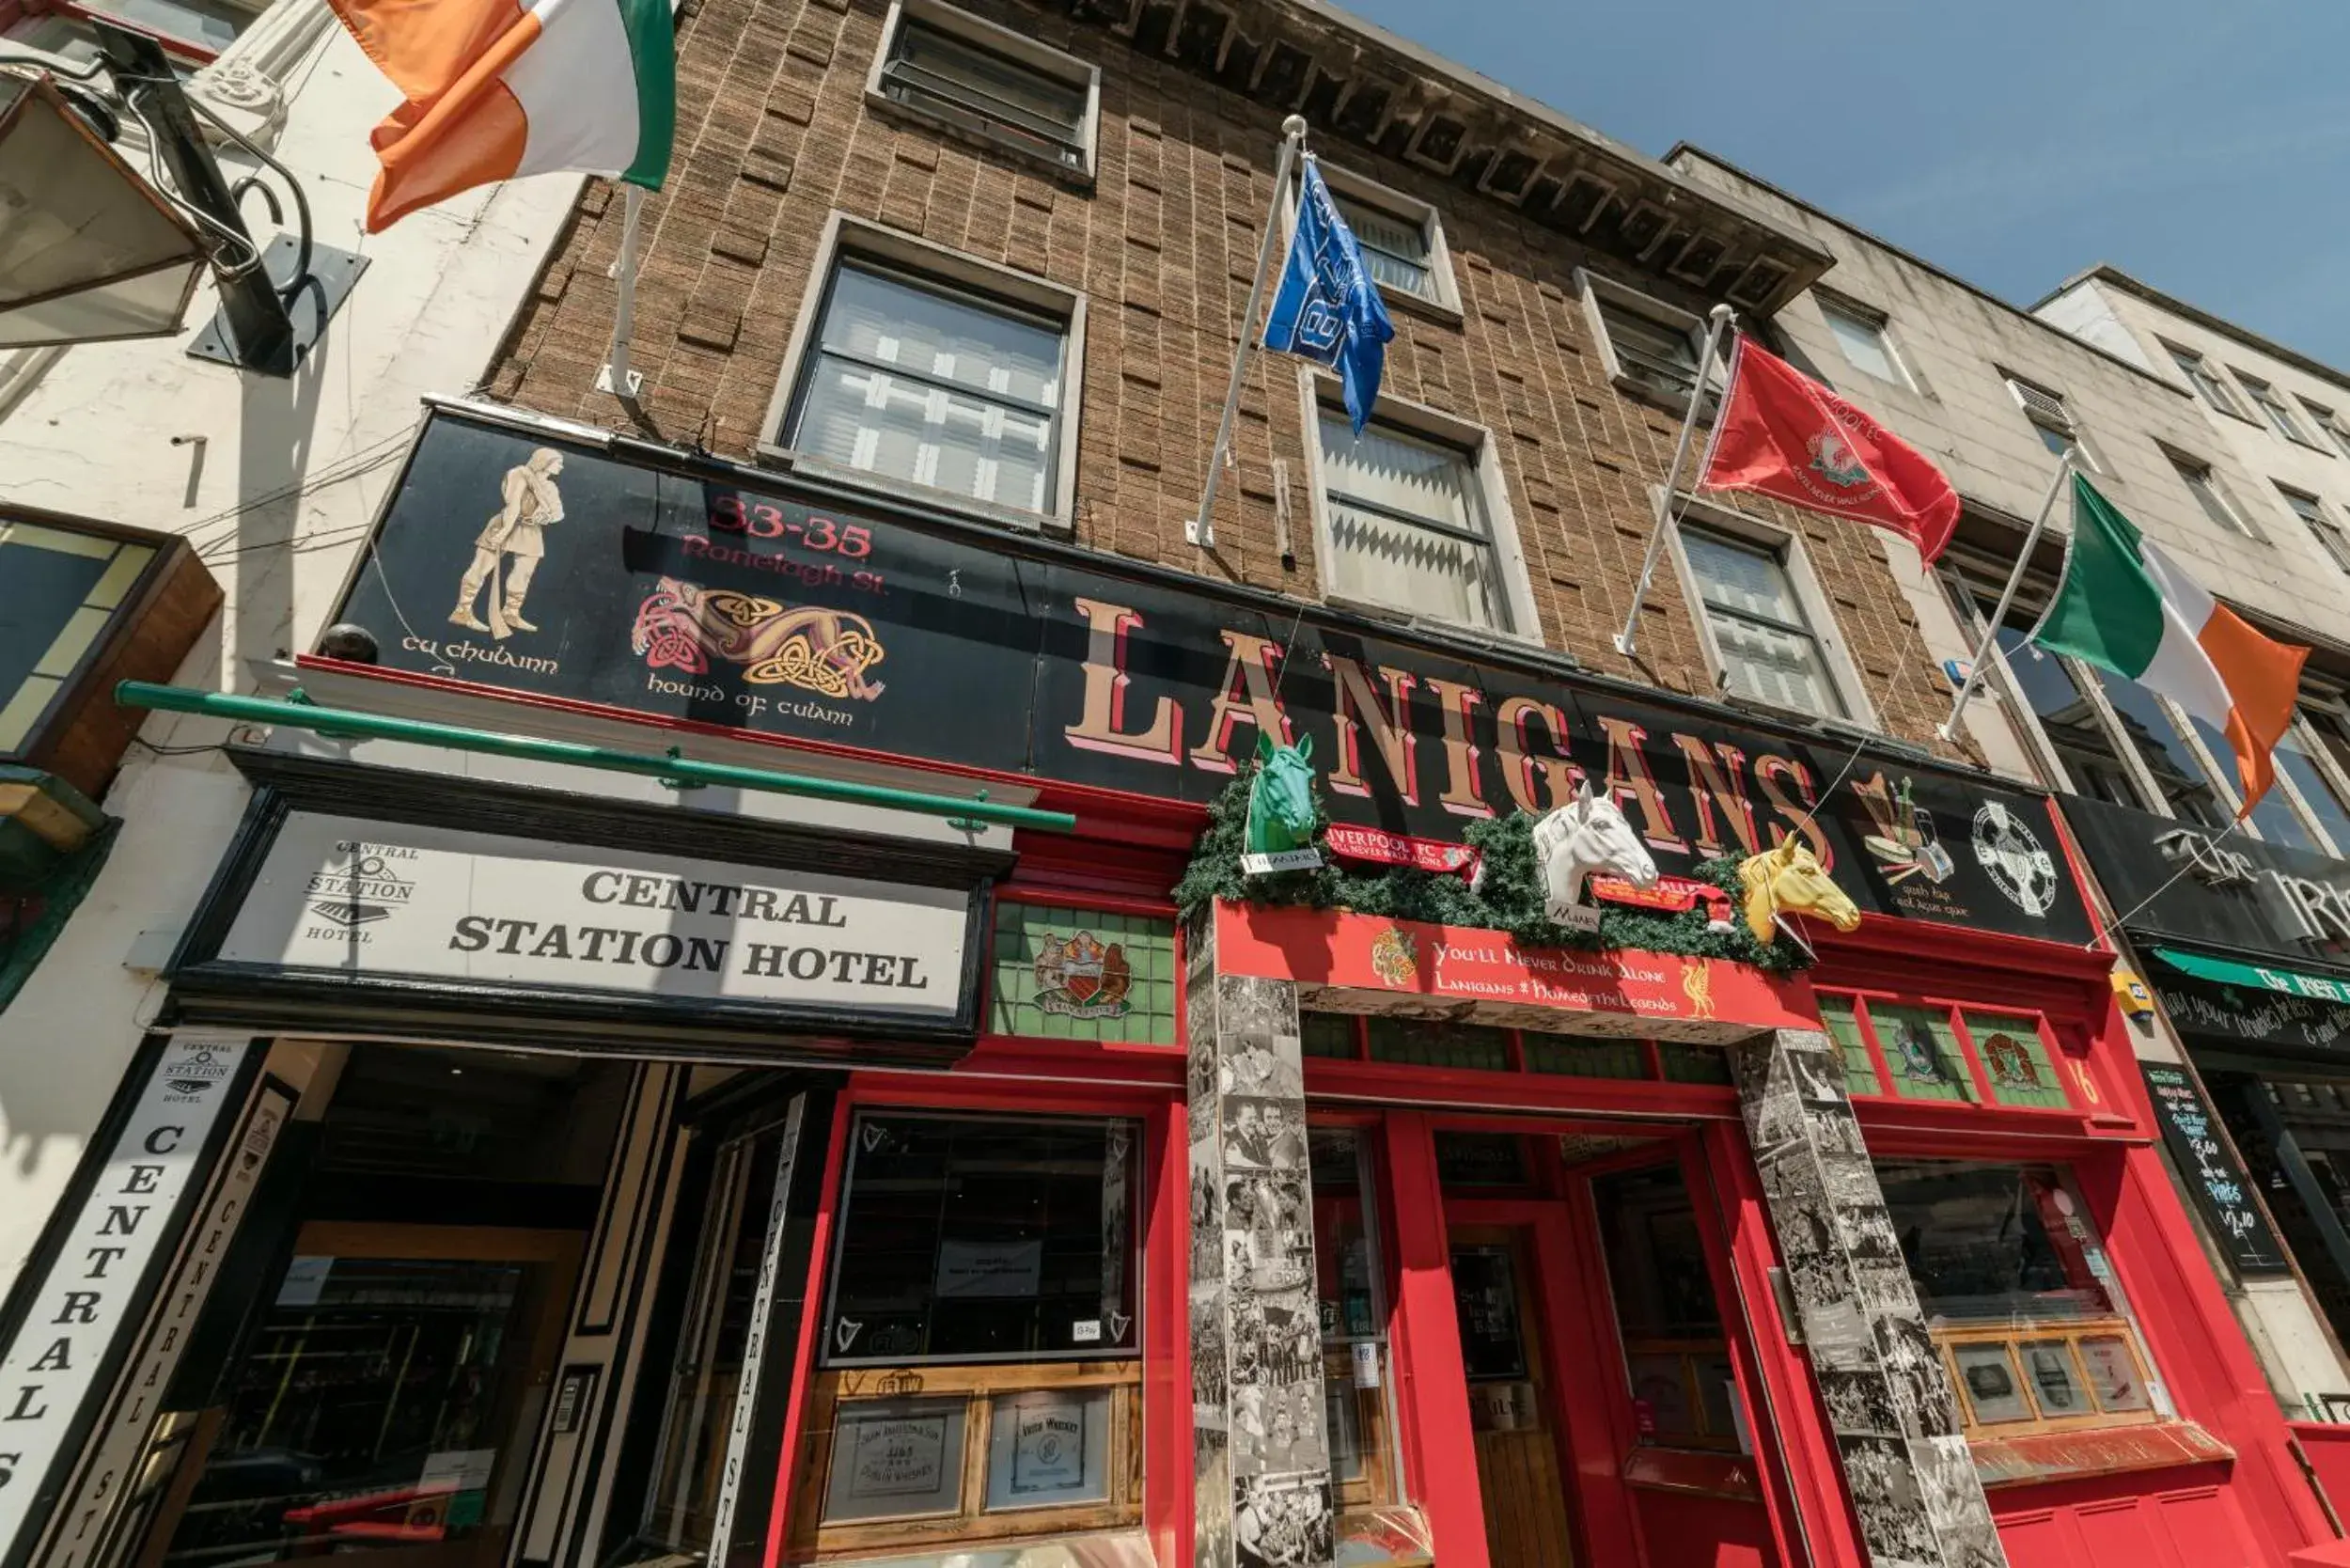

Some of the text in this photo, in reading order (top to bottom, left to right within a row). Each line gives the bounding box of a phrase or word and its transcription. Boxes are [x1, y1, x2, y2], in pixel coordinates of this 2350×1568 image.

[711, 496, 872, 557] 33-35
[680, 534, 843, 588] Ranelagh
[647, 672, 854, 727] hound of culann
[1066, 597, 1835, 876] LANIGANS
[336, 841, 419, 860] CENTRAL
[1417, 842, 1437, 856] FC
[307, 875, 414, 900] STATION
[580, 870, 849, 929] CENTRAL
[306, 926, 373, 944] HOTEL
[449, 915, 929, 990] STATION HOTEL
[4, 1125, 186, 1422] CENTRAL
[128, 1200, 237, 1425] CENTRAL
